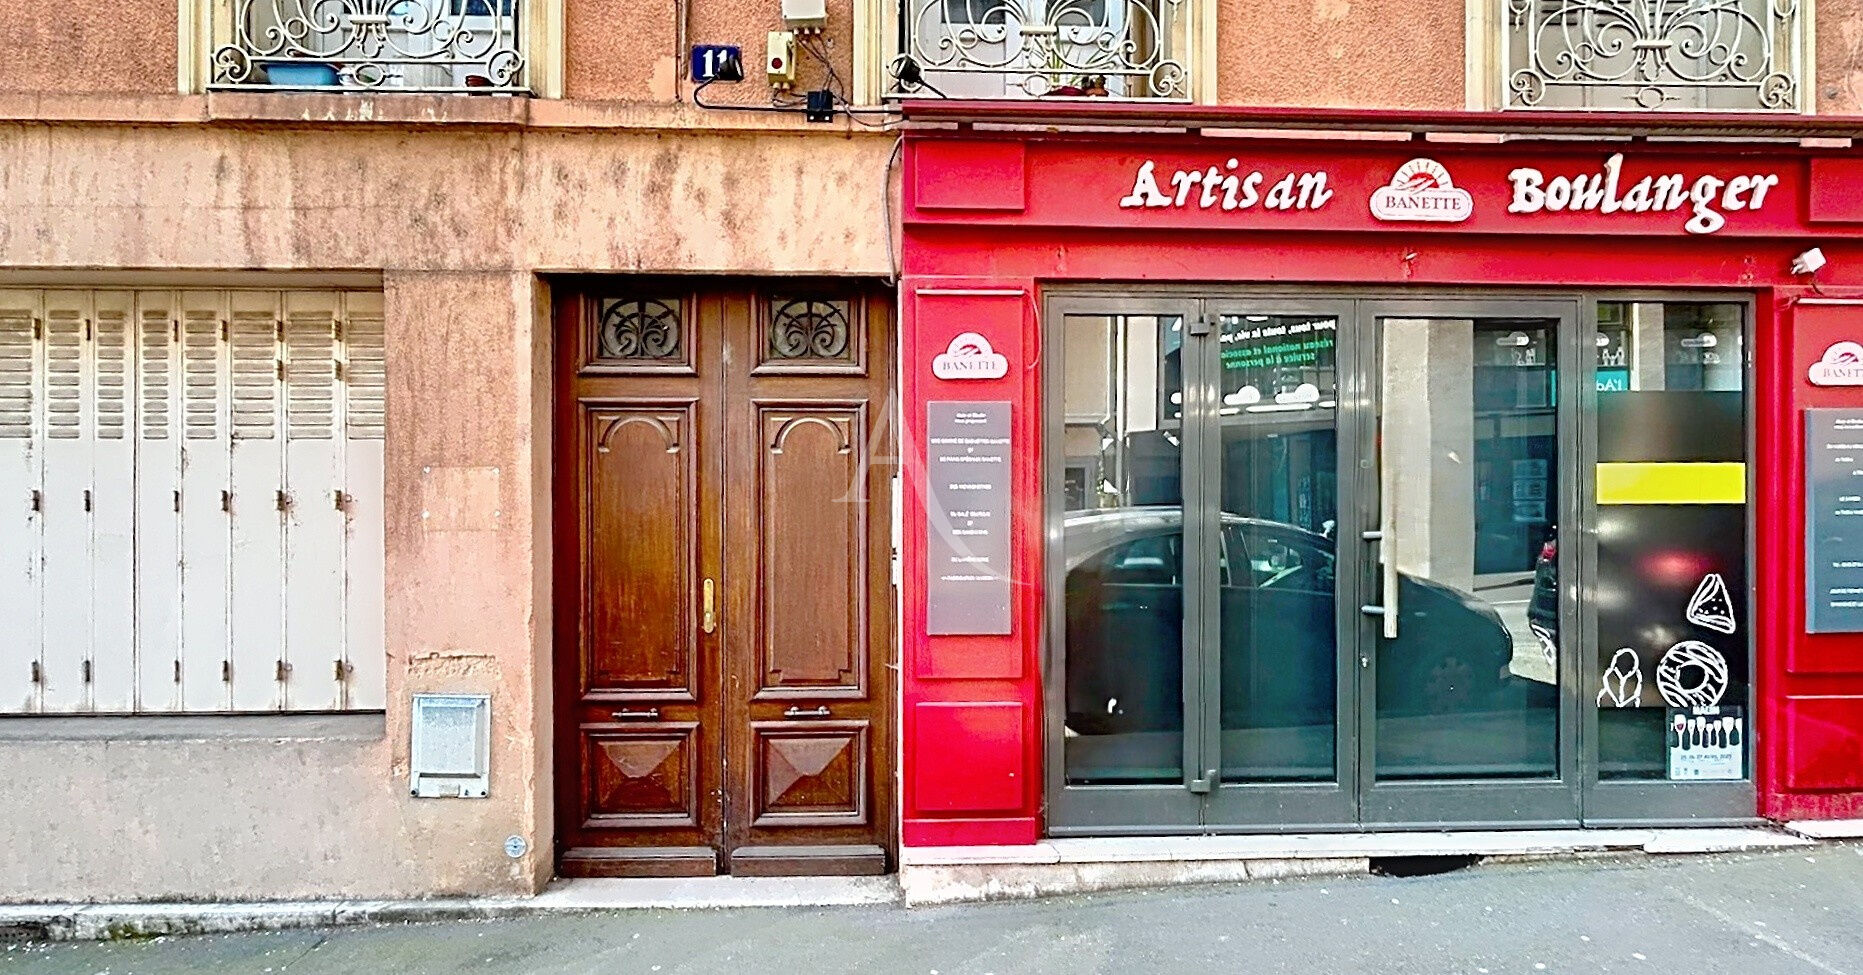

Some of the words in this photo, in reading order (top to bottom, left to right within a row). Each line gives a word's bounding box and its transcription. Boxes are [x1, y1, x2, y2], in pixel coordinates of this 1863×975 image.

[1119, 157, 1334, 210] Artisan
[1385, 196, 1461, 210] BANETTE
[1508, 153, 1779, 234] Boulanger
